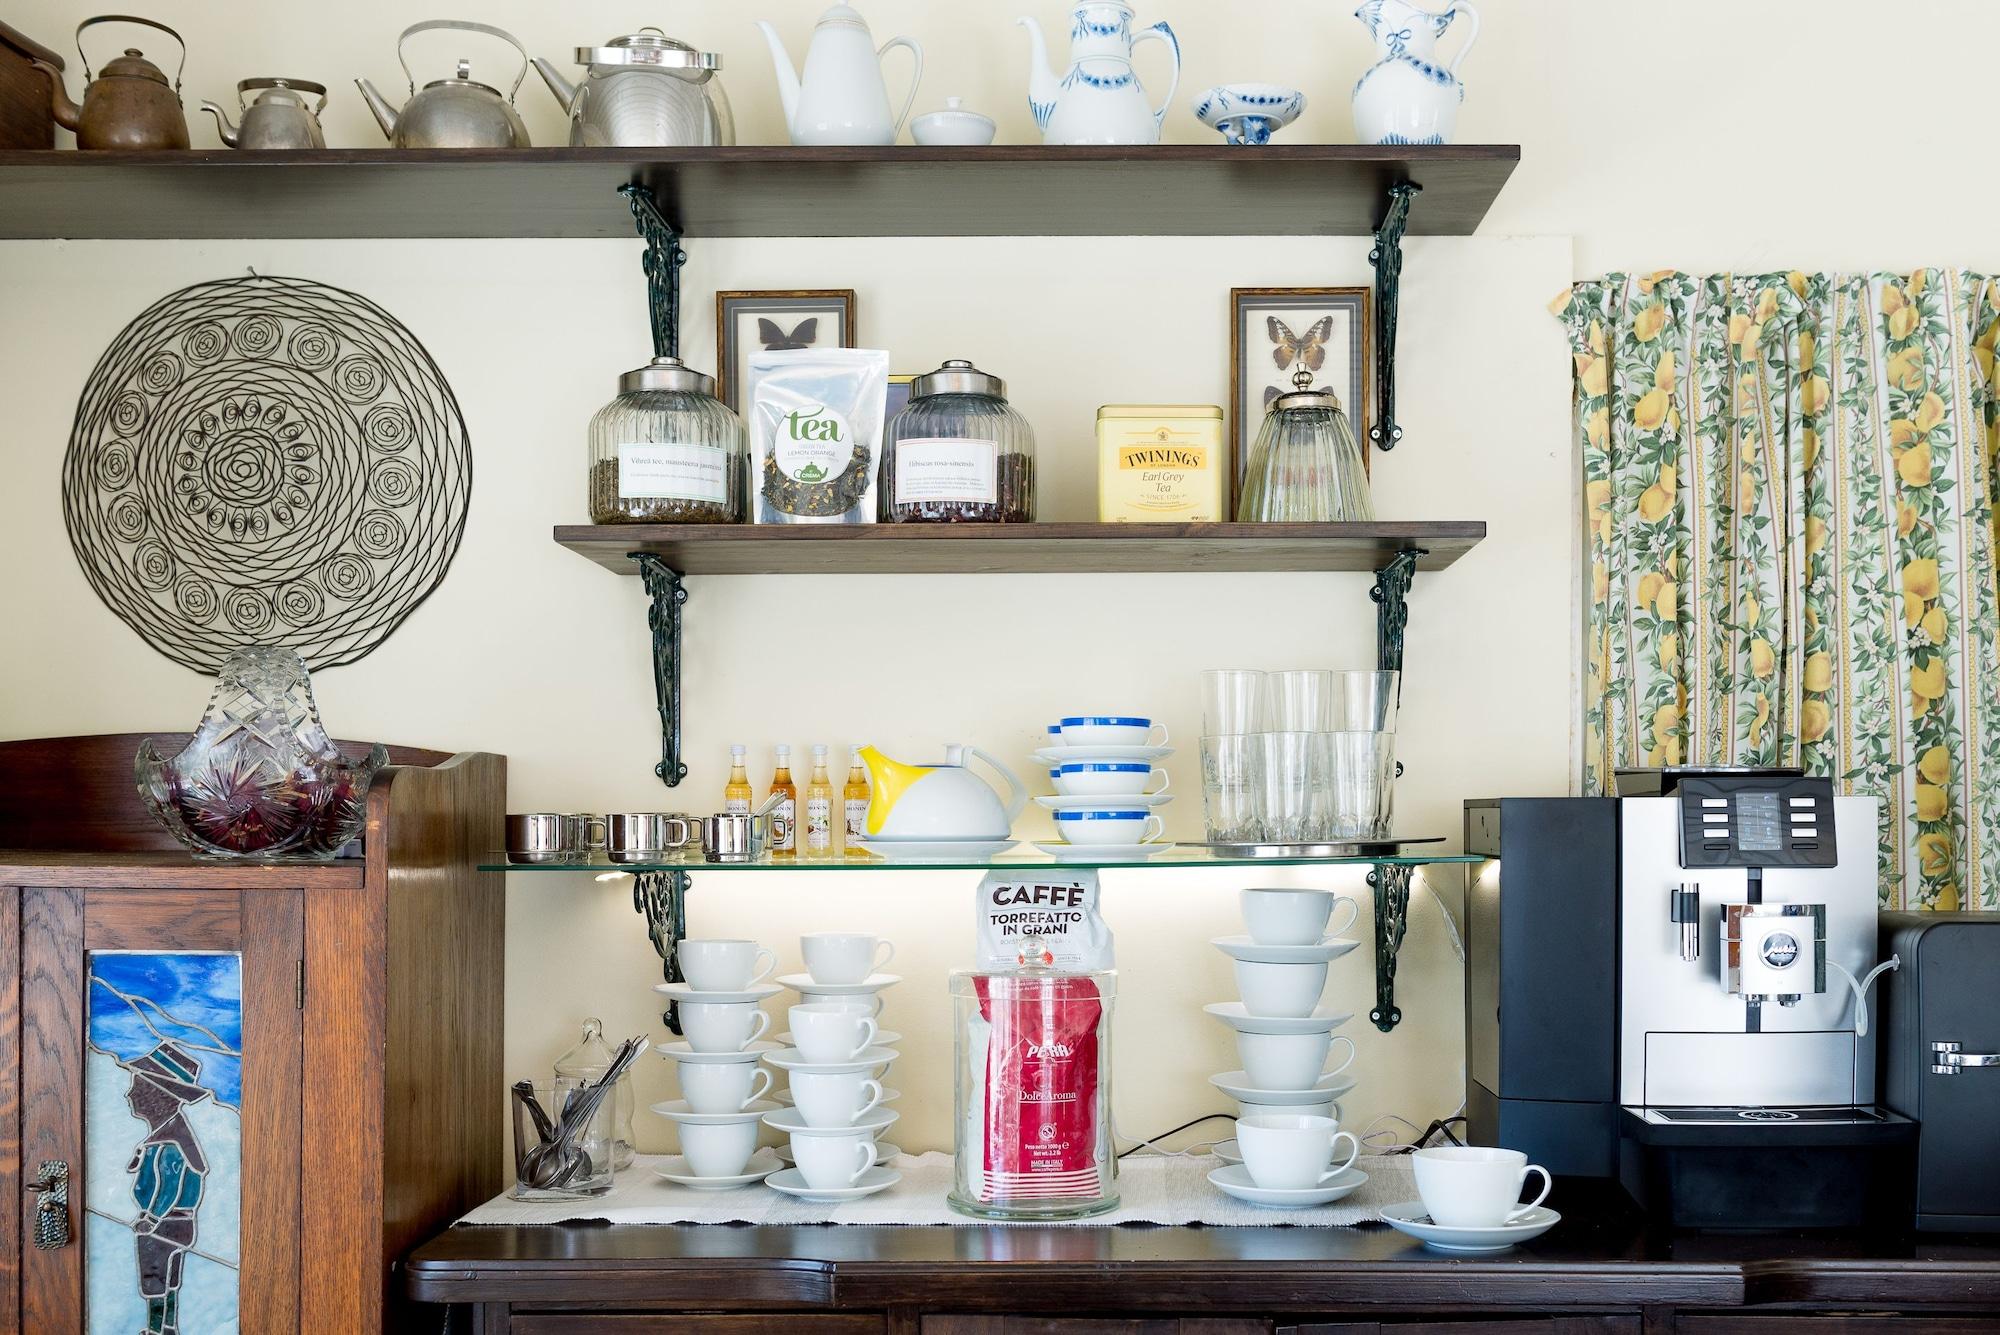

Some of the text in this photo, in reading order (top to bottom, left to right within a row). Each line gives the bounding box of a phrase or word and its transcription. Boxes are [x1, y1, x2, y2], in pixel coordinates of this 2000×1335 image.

[784, 407, 844, 442] tea
[1125, 450, 1200, 467] TWININGS
[1142, 472, 1184, 483] Earl Grey
[1156, 482, 1171, 492] Tea
[992, 882, 1085, 907] CAFFÈ
[990, 912, 1082, 925] TORREFATTO
[1003, 923, 1067, 935] IN GRANI
